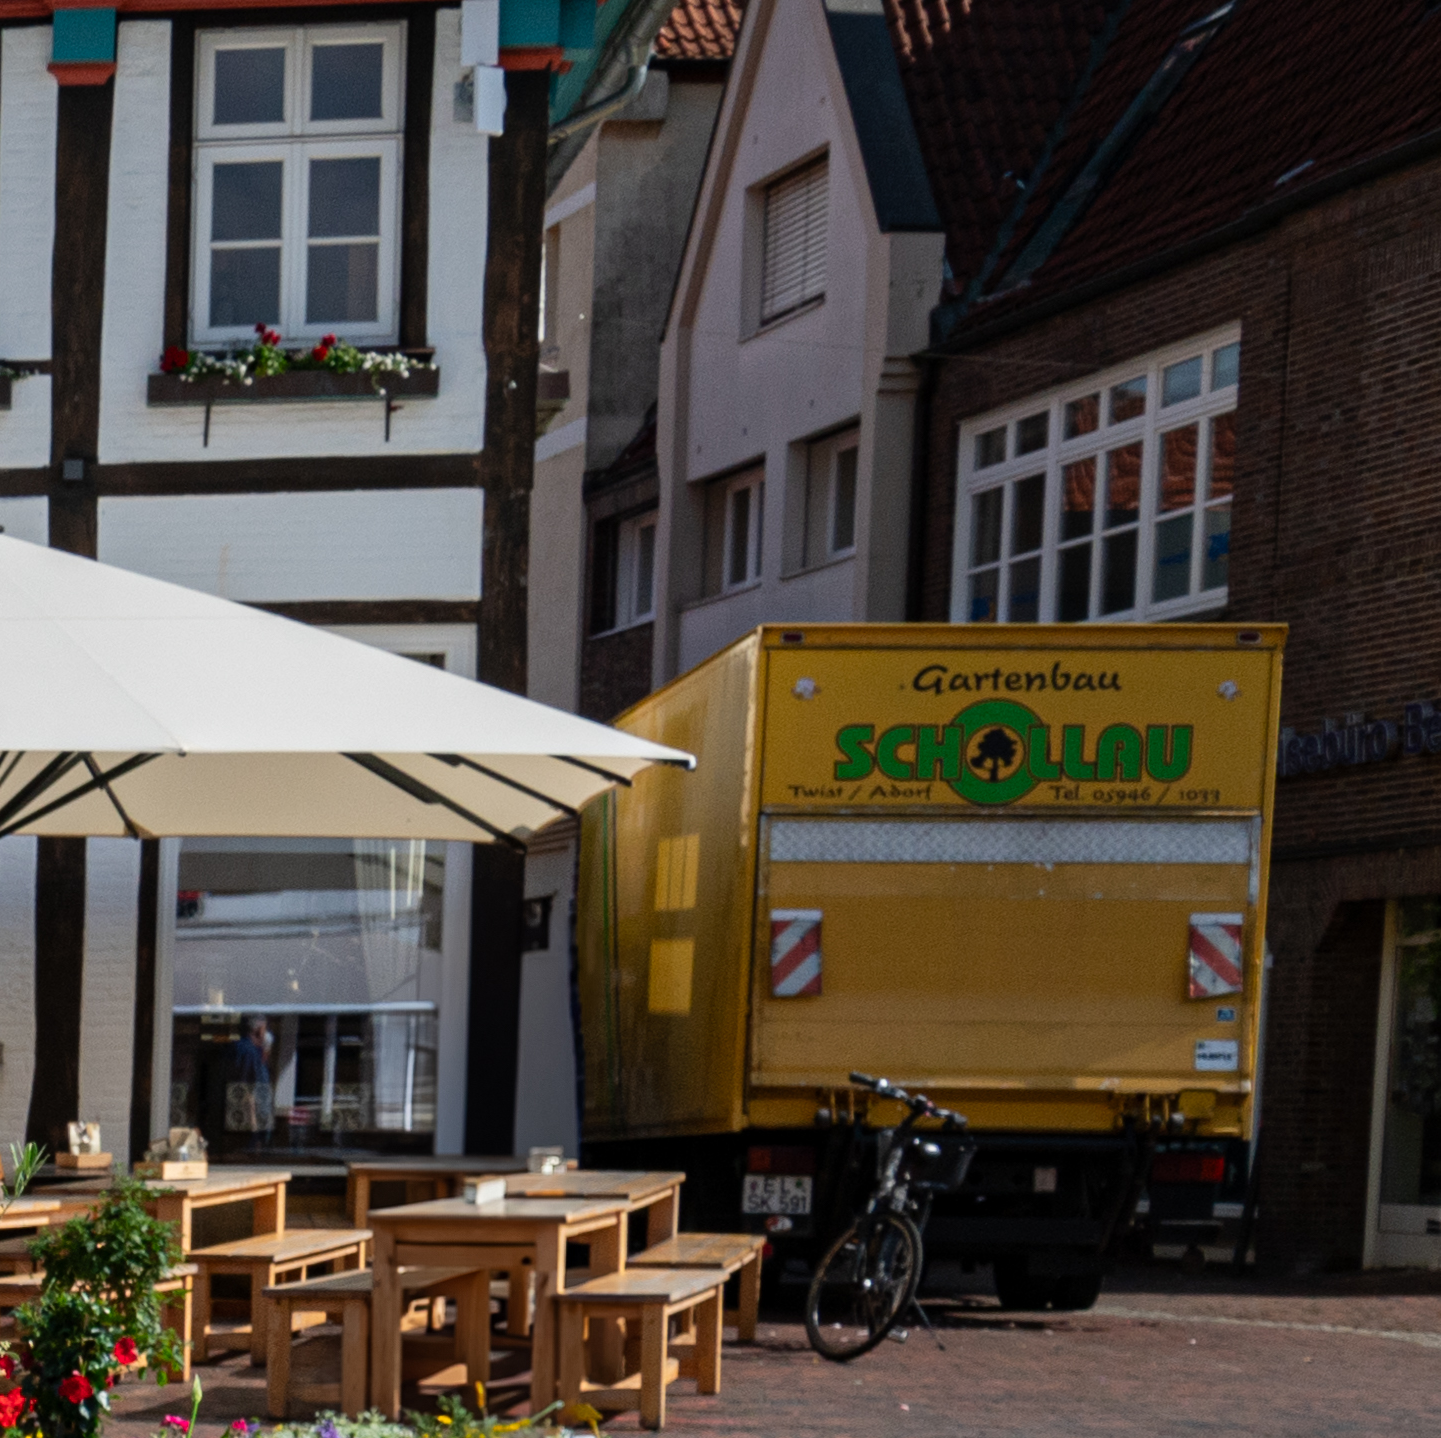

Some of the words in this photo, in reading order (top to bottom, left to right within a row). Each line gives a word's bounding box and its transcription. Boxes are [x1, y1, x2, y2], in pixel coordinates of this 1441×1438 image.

[912, 661, 1122, 694] Gartenbau
[833, 697, 1194, 806] SCHOLLAU
[788, 783, 844, 799] Twist
[869, 783, 933, 802] Adorf
[763, 1177, 791, 1194] EL
